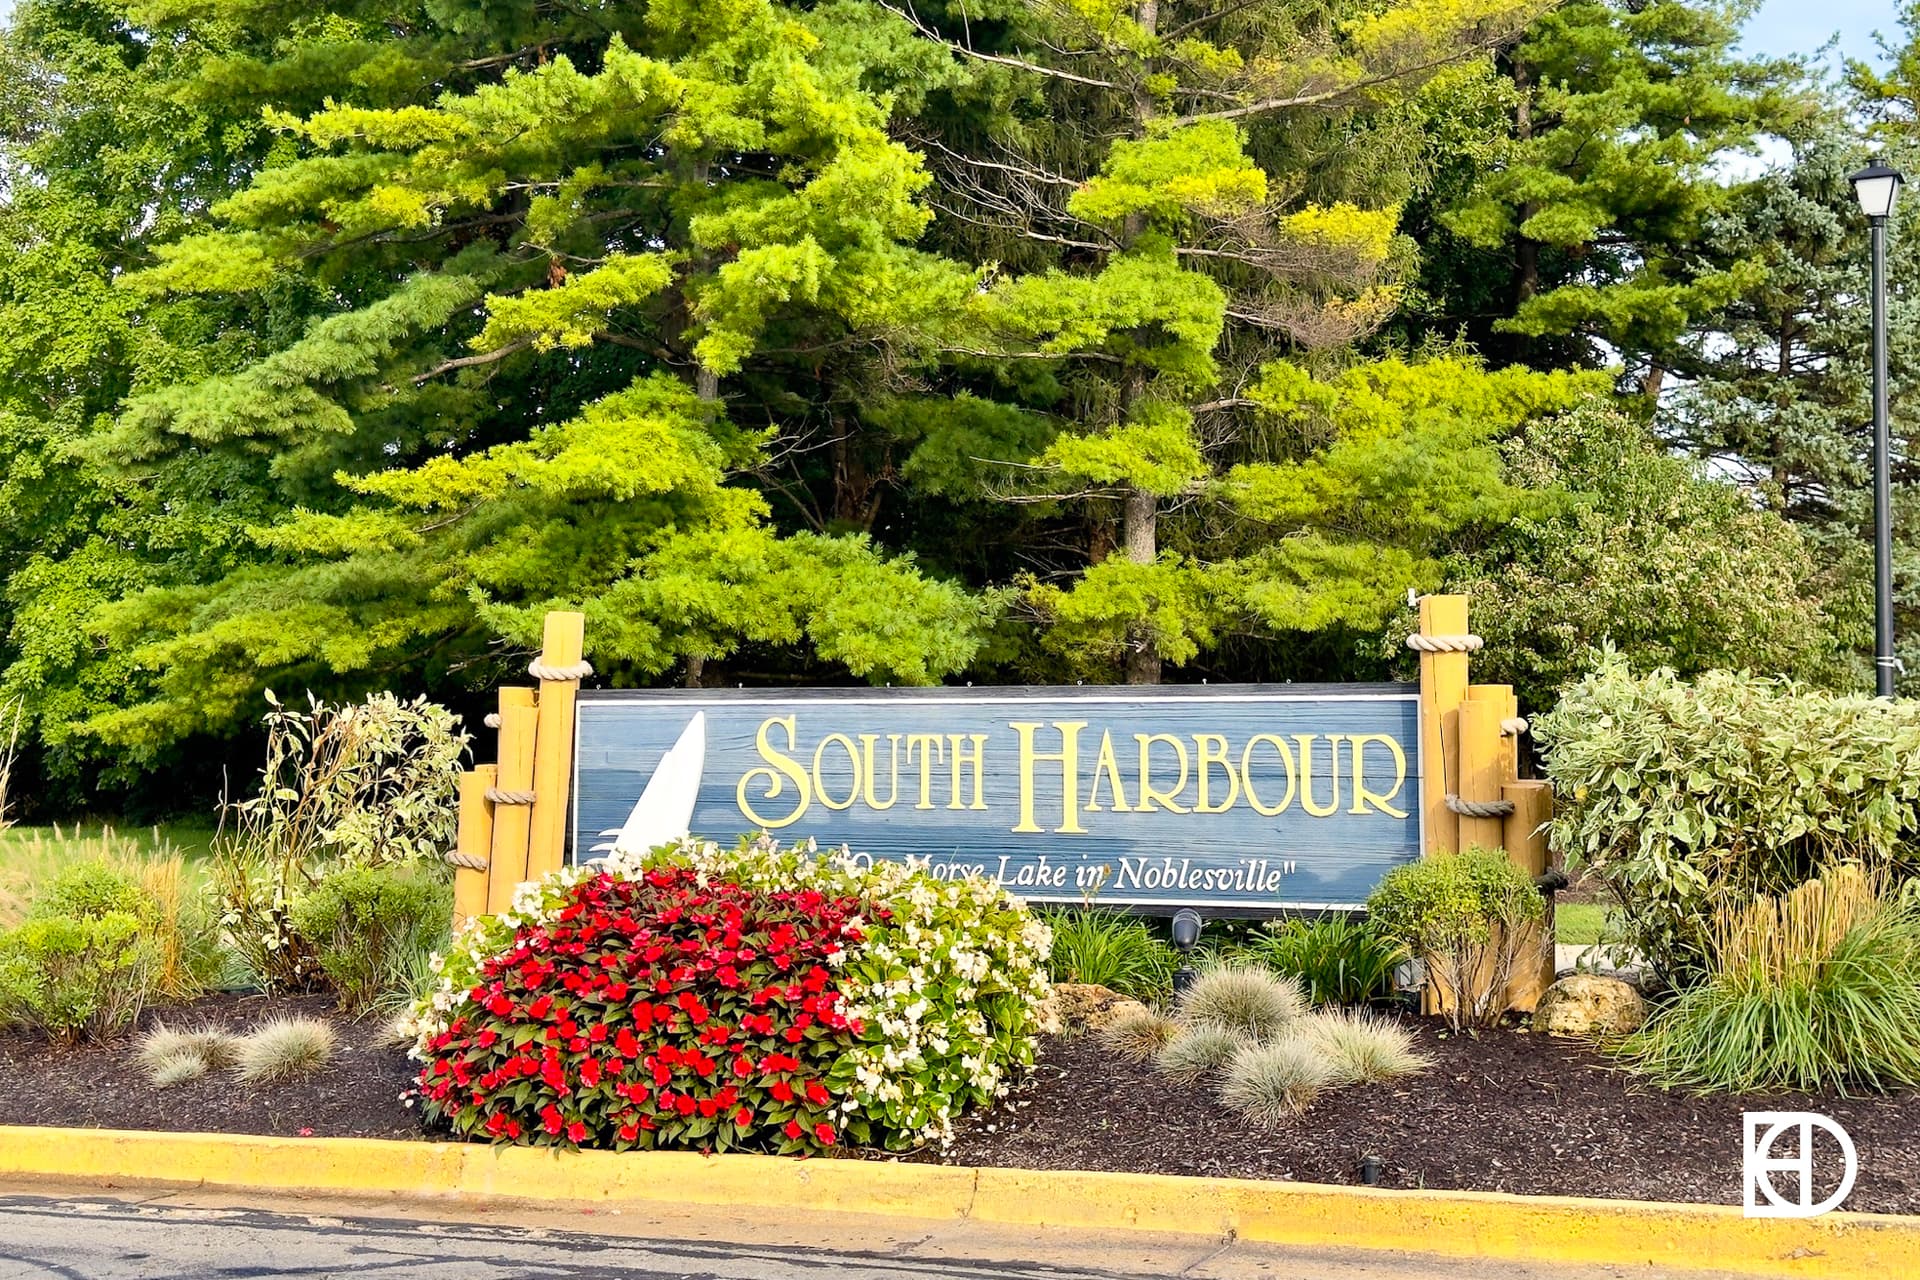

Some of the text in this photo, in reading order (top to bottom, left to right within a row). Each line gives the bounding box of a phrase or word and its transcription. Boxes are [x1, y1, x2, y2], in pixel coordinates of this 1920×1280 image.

[736, 713, 1411, 834] SOUTH HARBOUR
[997, 855, 1067, 887] Lake
[1075, 853, 1107, 887] in
[1112, 857, 1297, 892] Noblesville"
